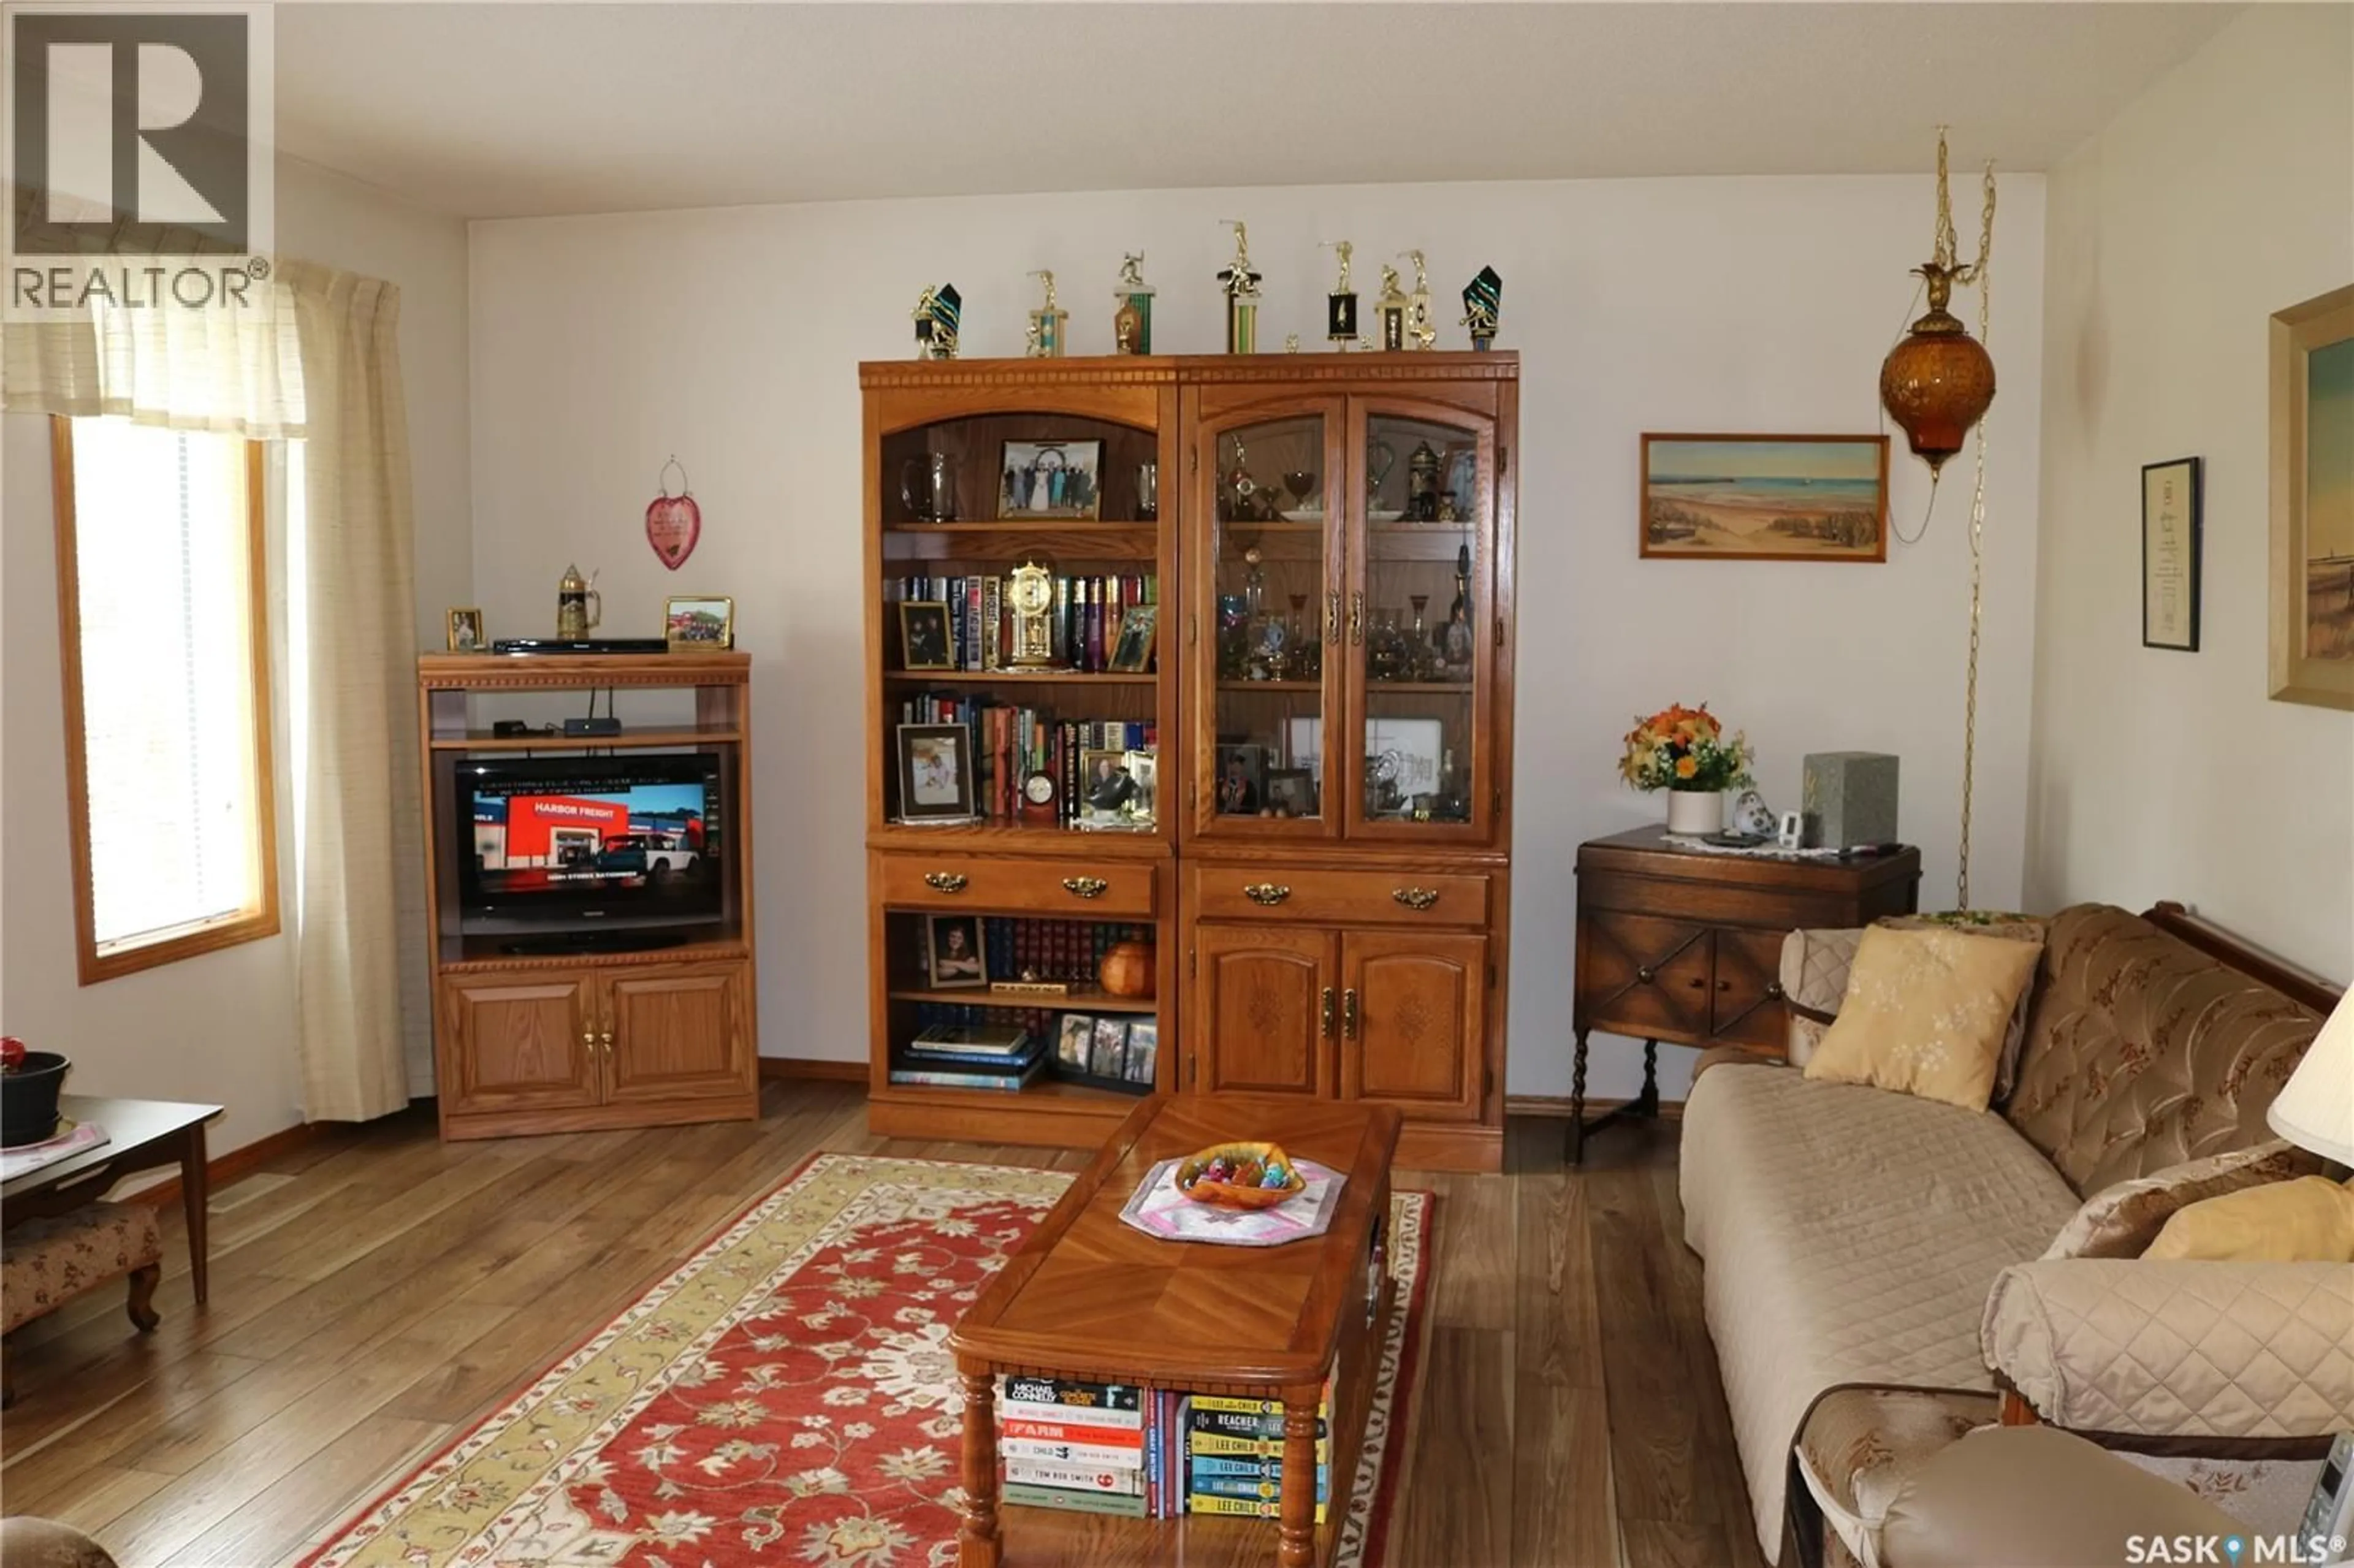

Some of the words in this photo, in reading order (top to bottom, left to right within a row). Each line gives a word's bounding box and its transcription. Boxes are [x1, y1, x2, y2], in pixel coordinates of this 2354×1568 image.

[535, 802, 577, 813] HARBOR
[580, 807, 614, 818] FREIGHT
[1013, 1383, 1053, 1395] MICHAEL
[1012, 1391, 1057, 1402] CONNELLY
[1212, 1399, 1224, 1409] LEE
[1237, 1401, 1257, 1410] CHILD
[1217, 1414, 1257, 1427] REACHER
[1014, 1422, 1065, 1438] FARM
[1216, 1442, 1228, 1451] LEE
[1231, 1442, 1254, 1452] CHILD
[1219, 1462, 1232, 1472] LEE
[1235, 1463, 1255, 1472] CHILD
[1071, 1474, 1094, 1483] SMITH
[1212, 1482, 1224, 1491] LEE
[1217, 1501, 1232, 1510] LEE
[1234, 1502, 1255, 1513] CHILD
